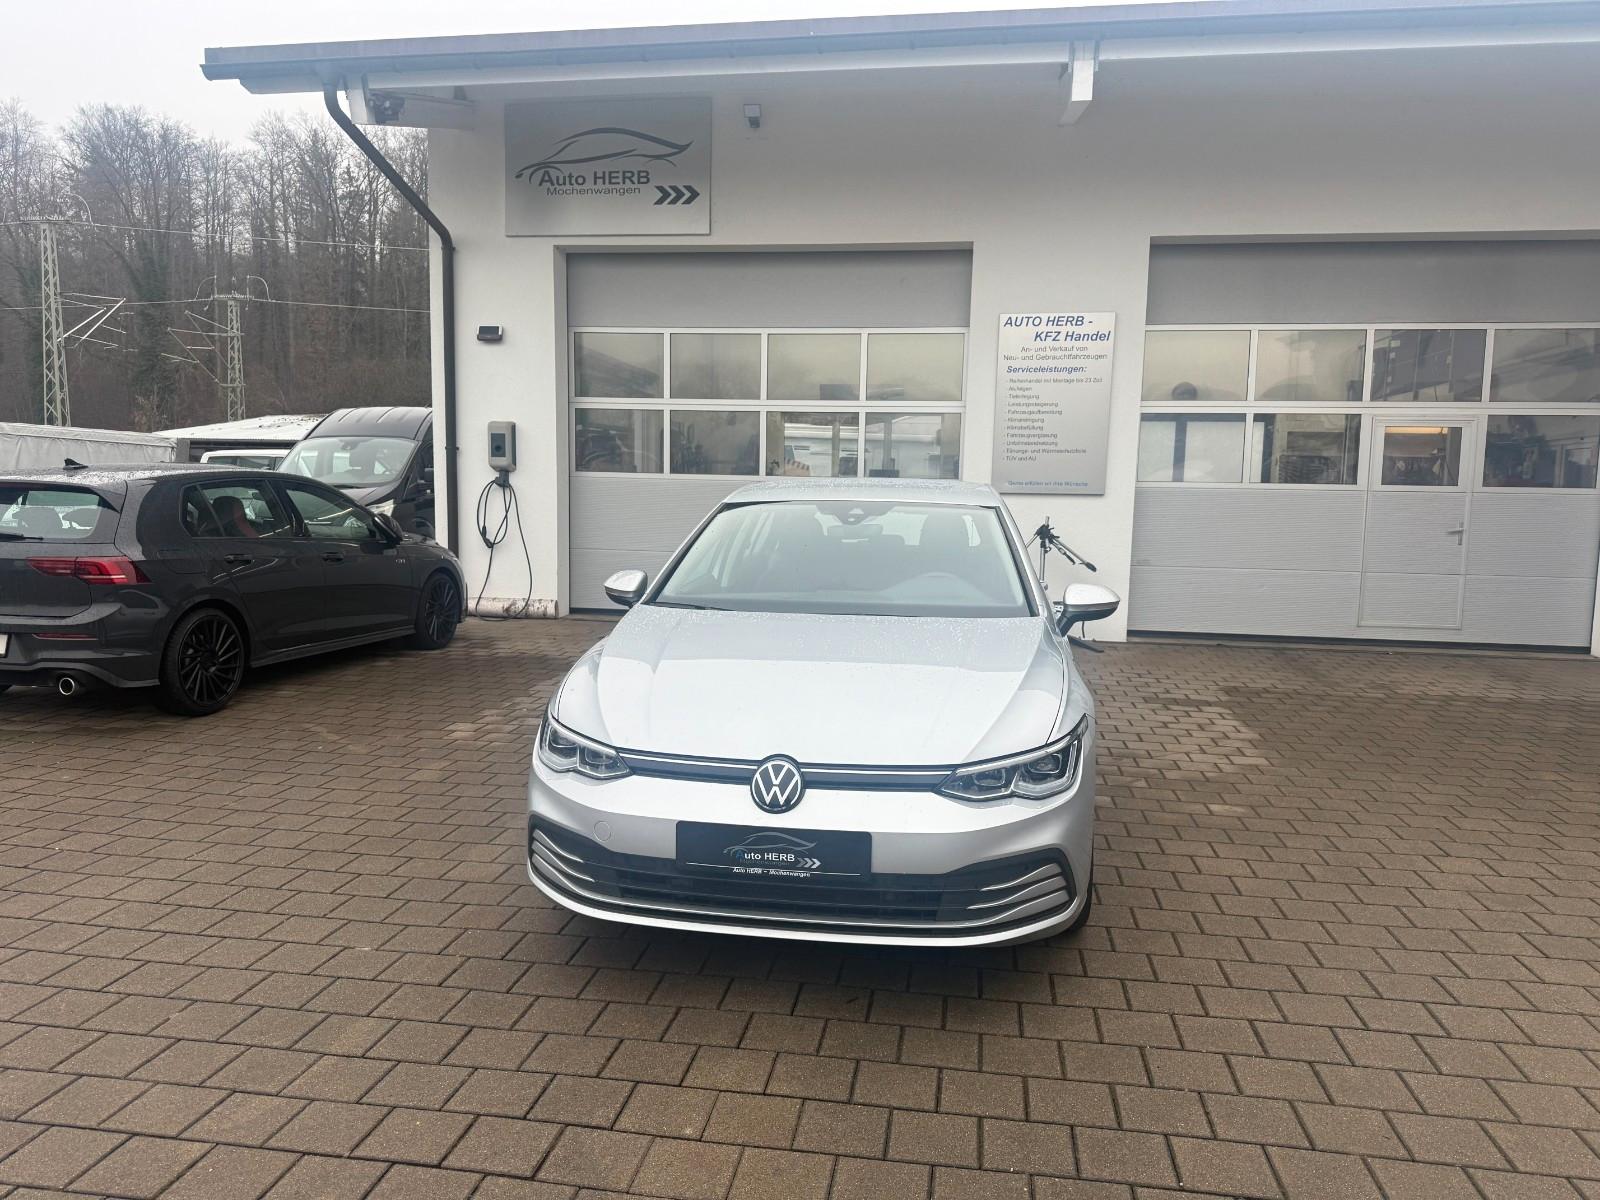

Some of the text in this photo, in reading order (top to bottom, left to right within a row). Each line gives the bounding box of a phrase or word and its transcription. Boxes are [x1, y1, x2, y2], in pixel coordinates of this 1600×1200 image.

[538, 170, 650, 187] Auto HERB
[546, 186, 641, 196] Mochenwangen
[1003, 316, 1042, 327] AUTO
[1045, 315, 1085, 327] HERB
[1033, 330, 1111, 342] KFZ Handel
[1006, 366, 1087, 374] Serviceleistungen:
[735, 850, 795, 862] Auto HERB
